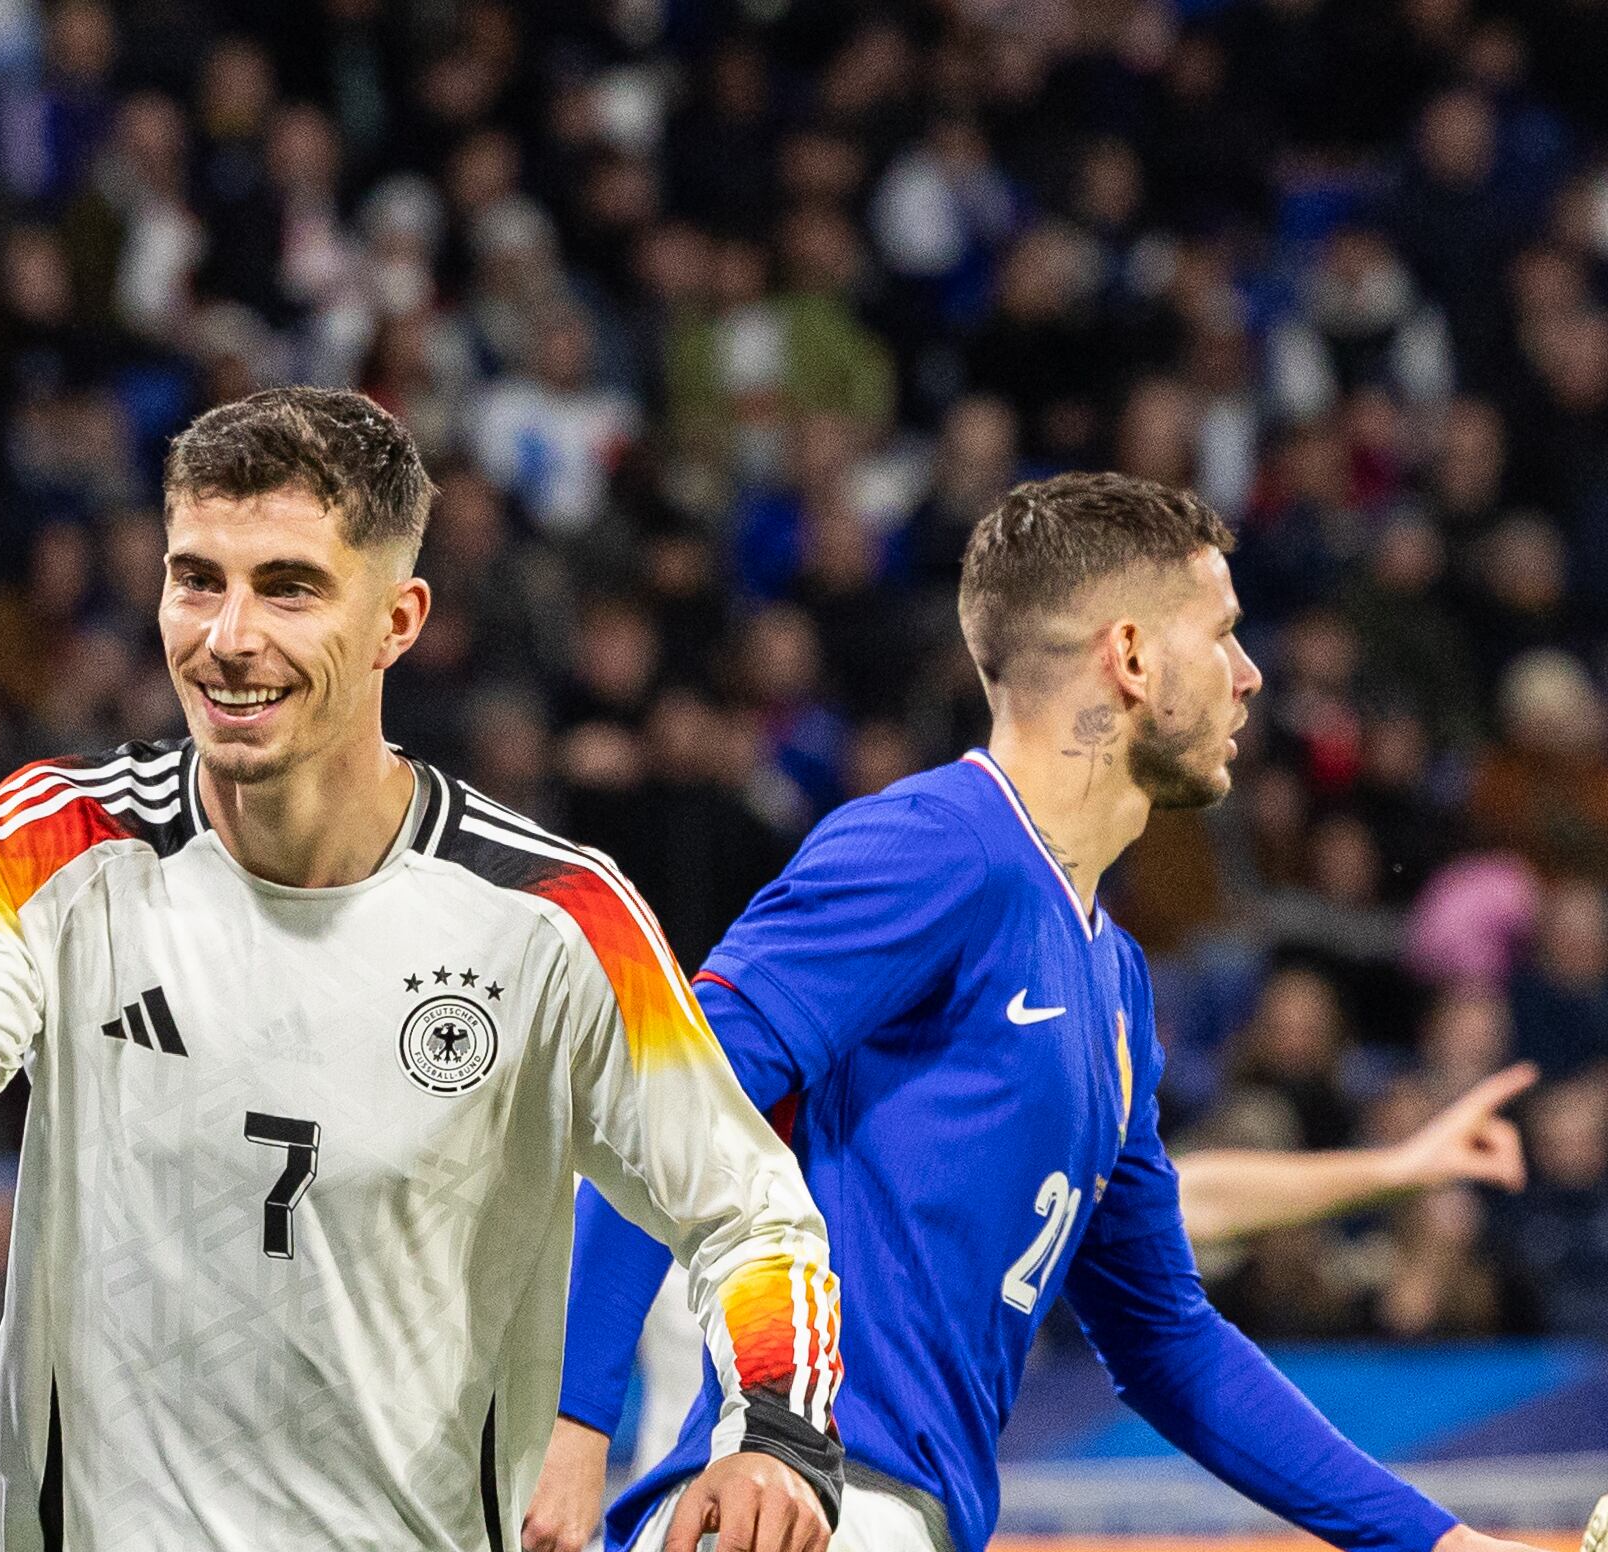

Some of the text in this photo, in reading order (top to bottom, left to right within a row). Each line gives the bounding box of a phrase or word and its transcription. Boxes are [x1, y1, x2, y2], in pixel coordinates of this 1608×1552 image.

[423, 1007, 479, 1028] DEUTSCHER
[414, 1051, 482, 1080] FUSSBALL-BUND
[245, 1111, 321, 1260] 7
